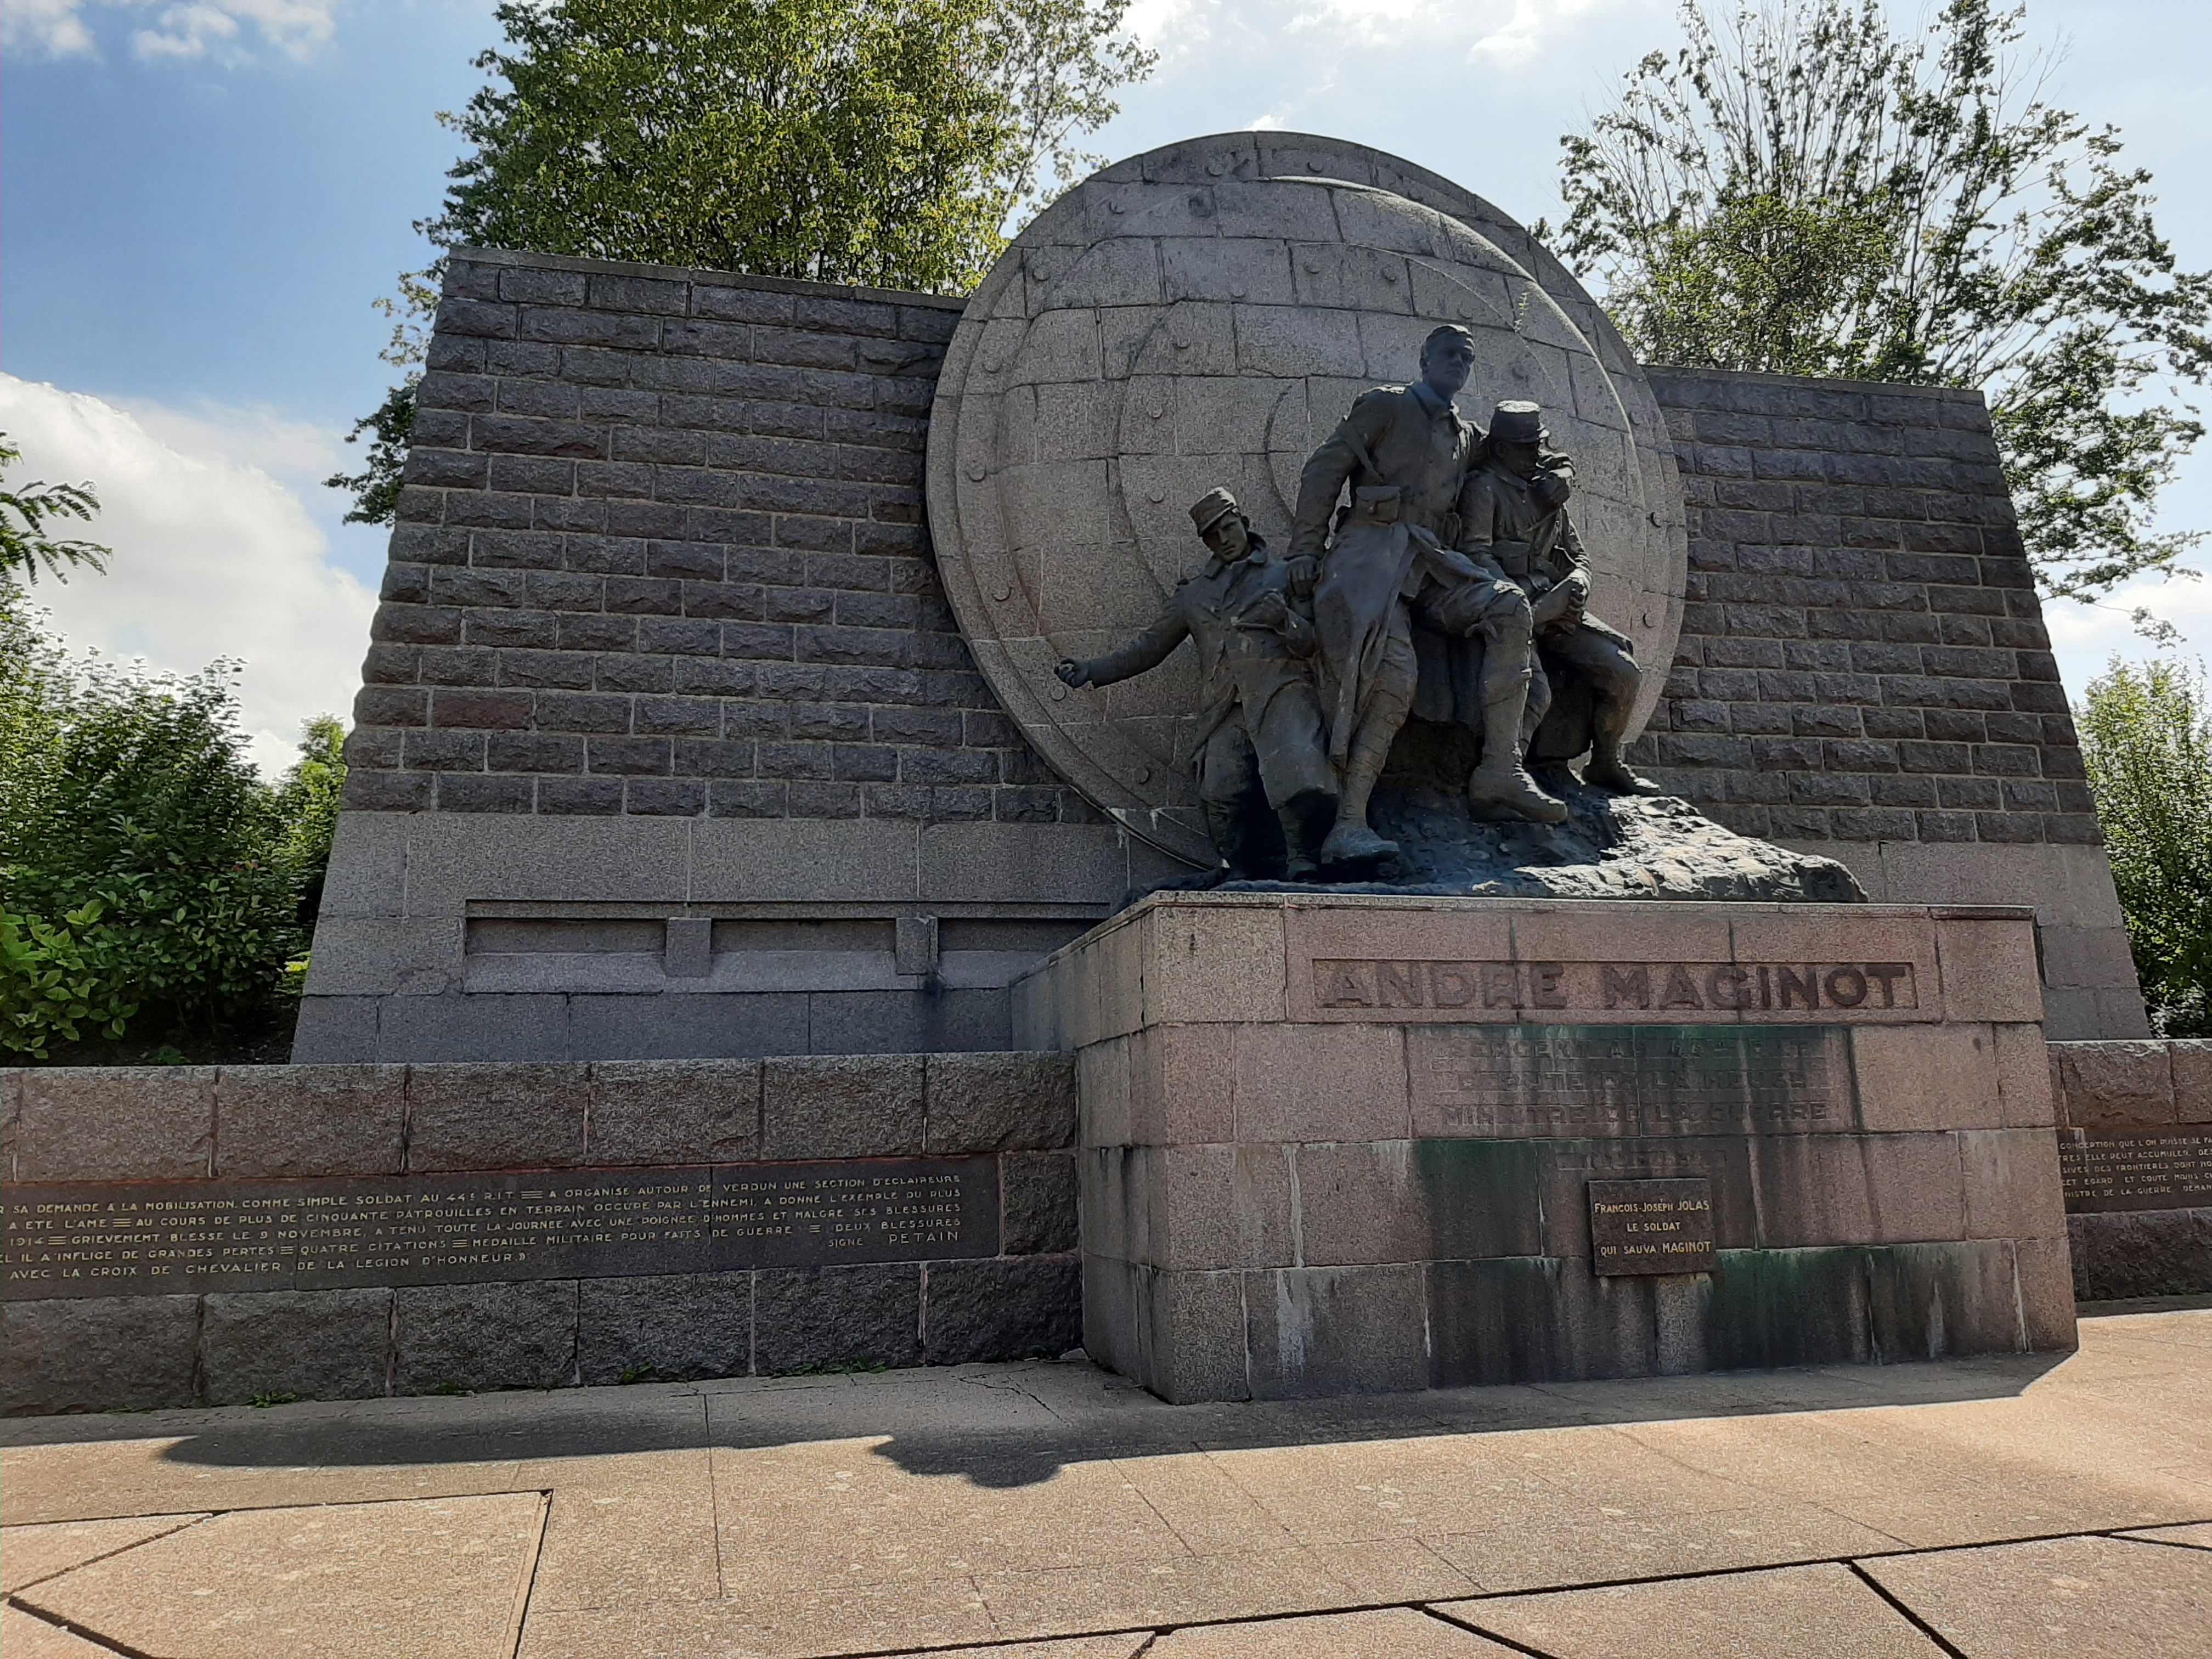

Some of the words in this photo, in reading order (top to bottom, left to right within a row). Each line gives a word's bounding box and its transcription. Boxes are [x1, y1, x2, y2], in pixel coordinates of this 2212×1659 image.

[1321, 963, 1567, 1009] ANDRE
[1602, 964, 1906, 1009] MAGINOT
[1653, 1070, 1691, 1089] LA
[1655, 1103, 1696, 1122] LA
[1710, 1102, 1827, 1121] GUERRE
[2060, 1141, 2114, 1150] CONCEPTION
[2119, 1139, 2135, 1148] QUE
[2160, 1137, 2187, 1146] PUISSE
[2086, 1153, 2106, 1161] ELLE
[2111, 1152, 2132, 1160] PEUT
[2095, 1164, 2111, 1173] DES
[2174, 1160, 2196, 1169] DONT
[2125, 1175, 2135, 1183] ET
[2141, 1173, 2168, 1183] COUTE
[13, 1205, 28, 1214] SA
[37, 1203, 99, 1214] DEMANDE
[121, 1203, 138, 1211] LA
[242, 1198, 290, 1208] COMME
[297, 1196, 348, 1207] SIMPLE
[356, 1194, 413, 1205] SOLDAT
[420, 1193, 439, 1203] AU
[549, 1190, 556, 1198] A
[565, 1187, 629, 1198] ORGANISE
[637, 1185, 689, 1195] AUTOUR
[698, 1184, 712, 1193] DE
[723, 1182, 777, 1192] VERDUN
[784, 1181, 806, 1190] UNE
[814, 1178, 865, 1189] SECTION
[2103, 1188, 2114, 1197] DE
[2137, 1186, 2171, 1195] GUERRE
[8, 1221, 17, 1230] A
[25, 1220, 54, 1230] ETE
[64, 1218, 108, 1229] L'AME
[136, 1217, 153, 1227] AU
[160, 1216, 205, 1226] COURS
[215, 1216, 231, 1225] DE
[239, 1215, 272, 1224] PLUS
[281, 1214, 297, 1223] DE
[306, 1211, 388, 1222] CINQUANTE
[396, 1206, 492, 1220] PATROUILLES
[500, 1206, 517, 1216] EN
[526, 1204, 585, 1215] TERRAIN
[594, 1201, 650, 1212] OCCUPE
[657, 1200, 681, 1209] PAR
[780, 1195, 821, 1205] DONNE
[830, 1192, 898, 1203] L'EXEMPLE
[906, 1190, 922, 1199] DU
[930, 1189, 960, 1198] PLUS
[1677, 1199, 1710, 1211] JOLAS
[10, 1236, 44, 1247] 1914
[170, 1232, 224, 1243] BLESSE
[233, 1231, 250, 1240] LE
[259, 1231, 268, 1239] 9
[389, 1224, 426, 1235] TENU
[435, 1223, 477, 1233] TOUTE
[487, 1223, 501, 1231] LA
[507, 1220, 563, 1231] JOURNEE
[571, 1218, 602, 1228] AVEC
[610, 1217, 634, 1227] UNE
[642, 1215, 696, 1225] POIGNEE
[703, 1212, 764, 1223] D'HOMMES
[773, 1211, 787, 1220] ET
[795, 1209, 843, 1219] MALGRE
[854, 1207, 876, 1216] SES
[886, 1203, 960, 1215] BLESSURES
[1626, 1223, 1639, 1232] LE
[1644, 1222, 1681, 1232] SOLDAT
[21, 1253, 33, 1262] IL
[41, 1253, 50, 1262] A
[122, 1250, 138, 1259] DE
[148, 1248, 213, 1259] GRANDES
[223, 1246, 274, 1256] PERTES
[300, 1243, 358, 1256] QUATRE
[368, 1240, 446, 1251] CITATIONS
[473, 1237, 537, 1247] MEDAILLE
[546, 1233, 612, 1244] MILITAIRE
[621, 1231, 656, 1242] POUR
[664, 1229, 701, 1239] FAITS
[712, 1228, 729, 1238] DE
[736, 1226, 793, 1237] GUERRE
[836, 1222, 871, 1233] DEUX
[881, 1218, 960, 1230] BLESSURES
[828, 1237, 864, 1248] SIGNE
[888, 1231, 959, 1245] PETAIN
[1600, 1245, 1617, 1257] QUI
[1623, 1244, 1657, 1255] SAUVA
[1662, 1240, 1711, 1254] MAGINOT
[10, 1269, 50, 1280] AVEC
[63, 1268, 80, 1278] LA
[91, 1266, 138, 1277] CROIX
[151, 1265, 170, 1276] DE
[185, 1262, 281, 1274] CHEVALIER
[297, 1261, 315, 1271] DE
[327, 1260, 346, 1269] LA
[356, 1257, 410, 1268] LEGION
